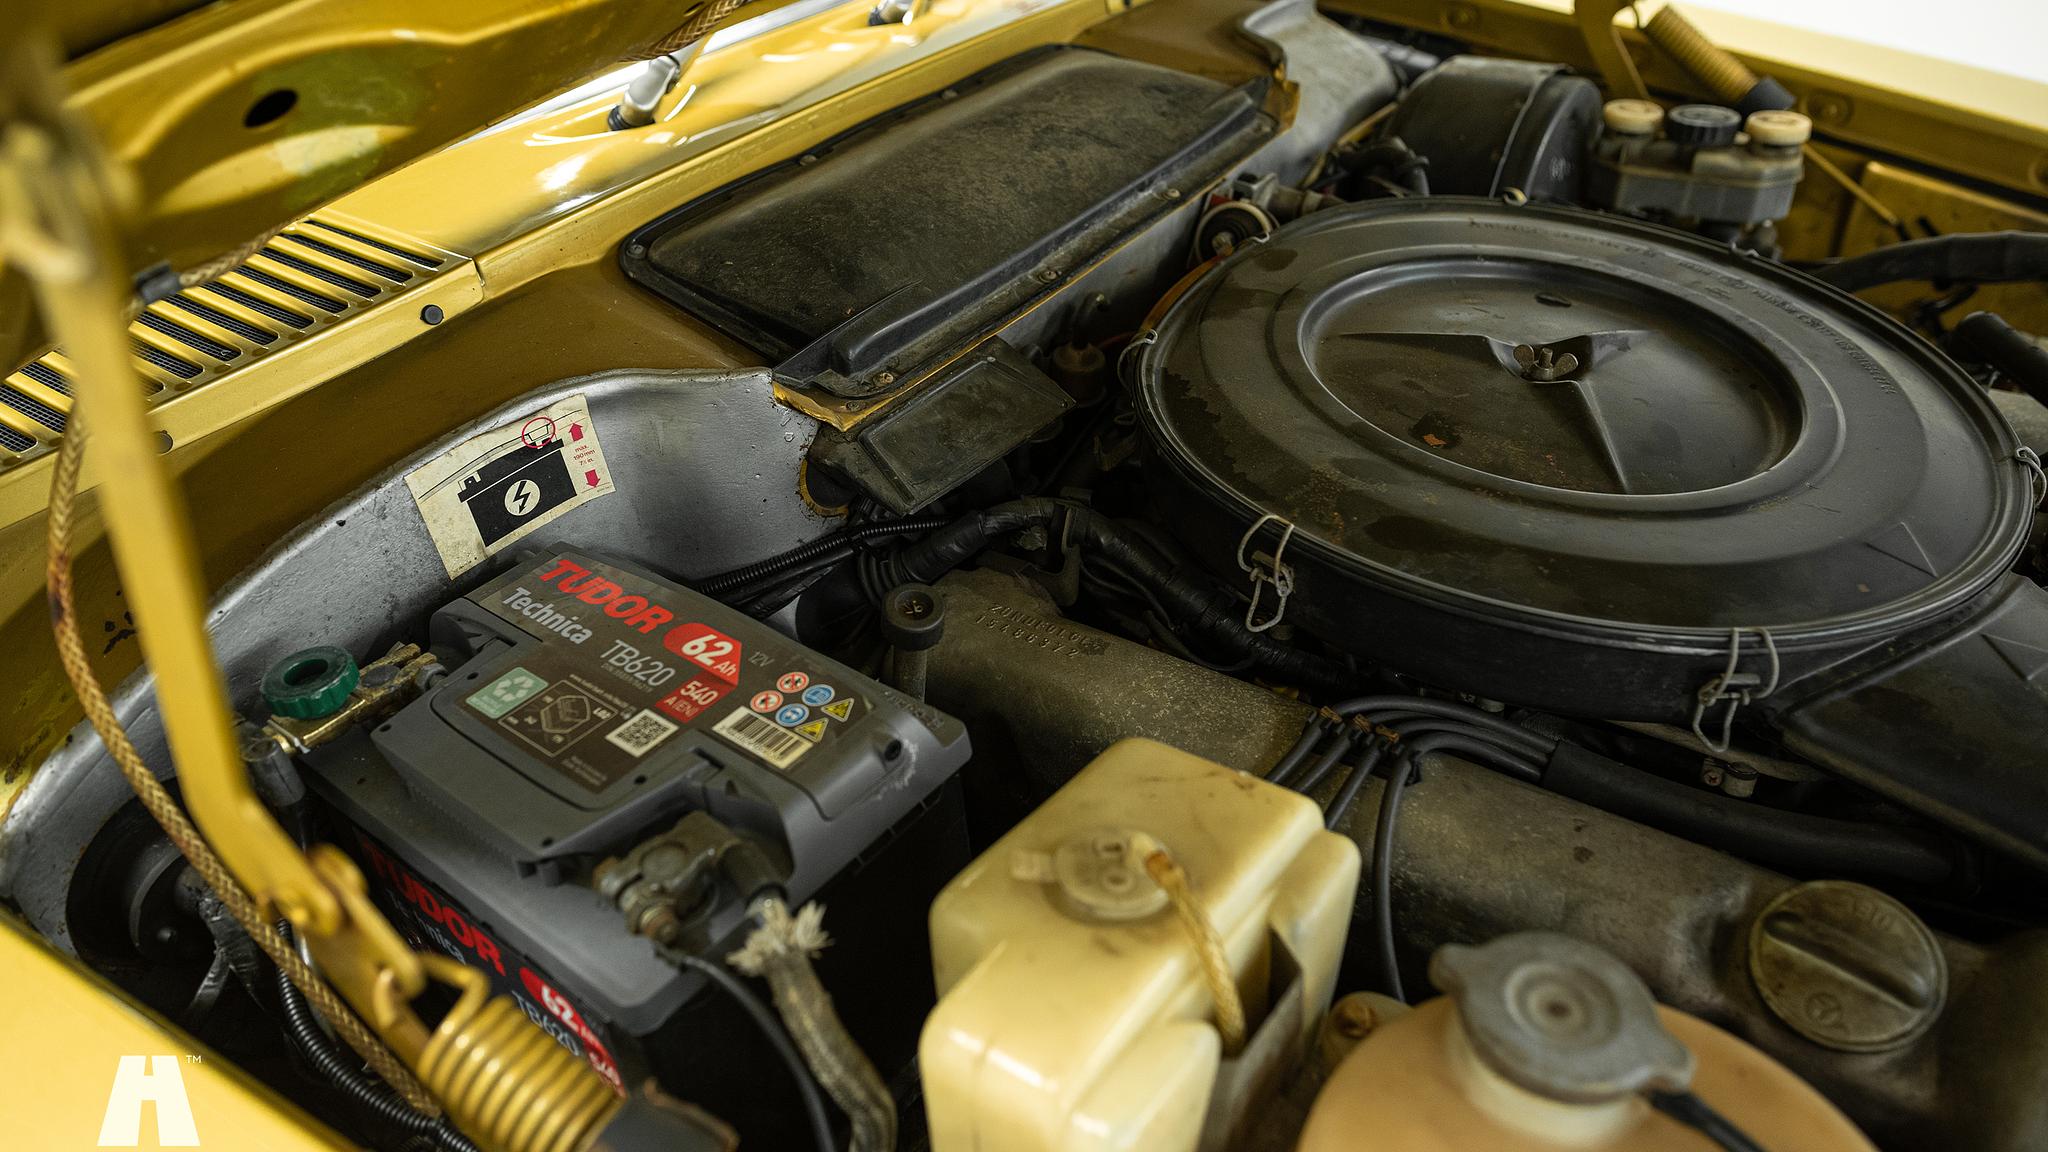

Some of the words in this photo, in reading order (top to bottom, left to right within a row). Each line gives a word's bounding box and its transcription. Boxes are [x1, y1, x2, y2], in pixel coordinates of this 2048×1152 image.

[502, 587, 594, 646] Technica
[538, 558, 674, 635] TUDOR
[599, 638, 676, 687] TB620
[680, 633, 735, 667] 62
[716, 659, 737, 677] Ah
[748, 650, 776, 668] 12V
[662, 694, 678, 708] A
[679, 679, 719, 706] 540
[360, 838, 507, 977] TUDOR
[541, 984, 579, 1033] 62
